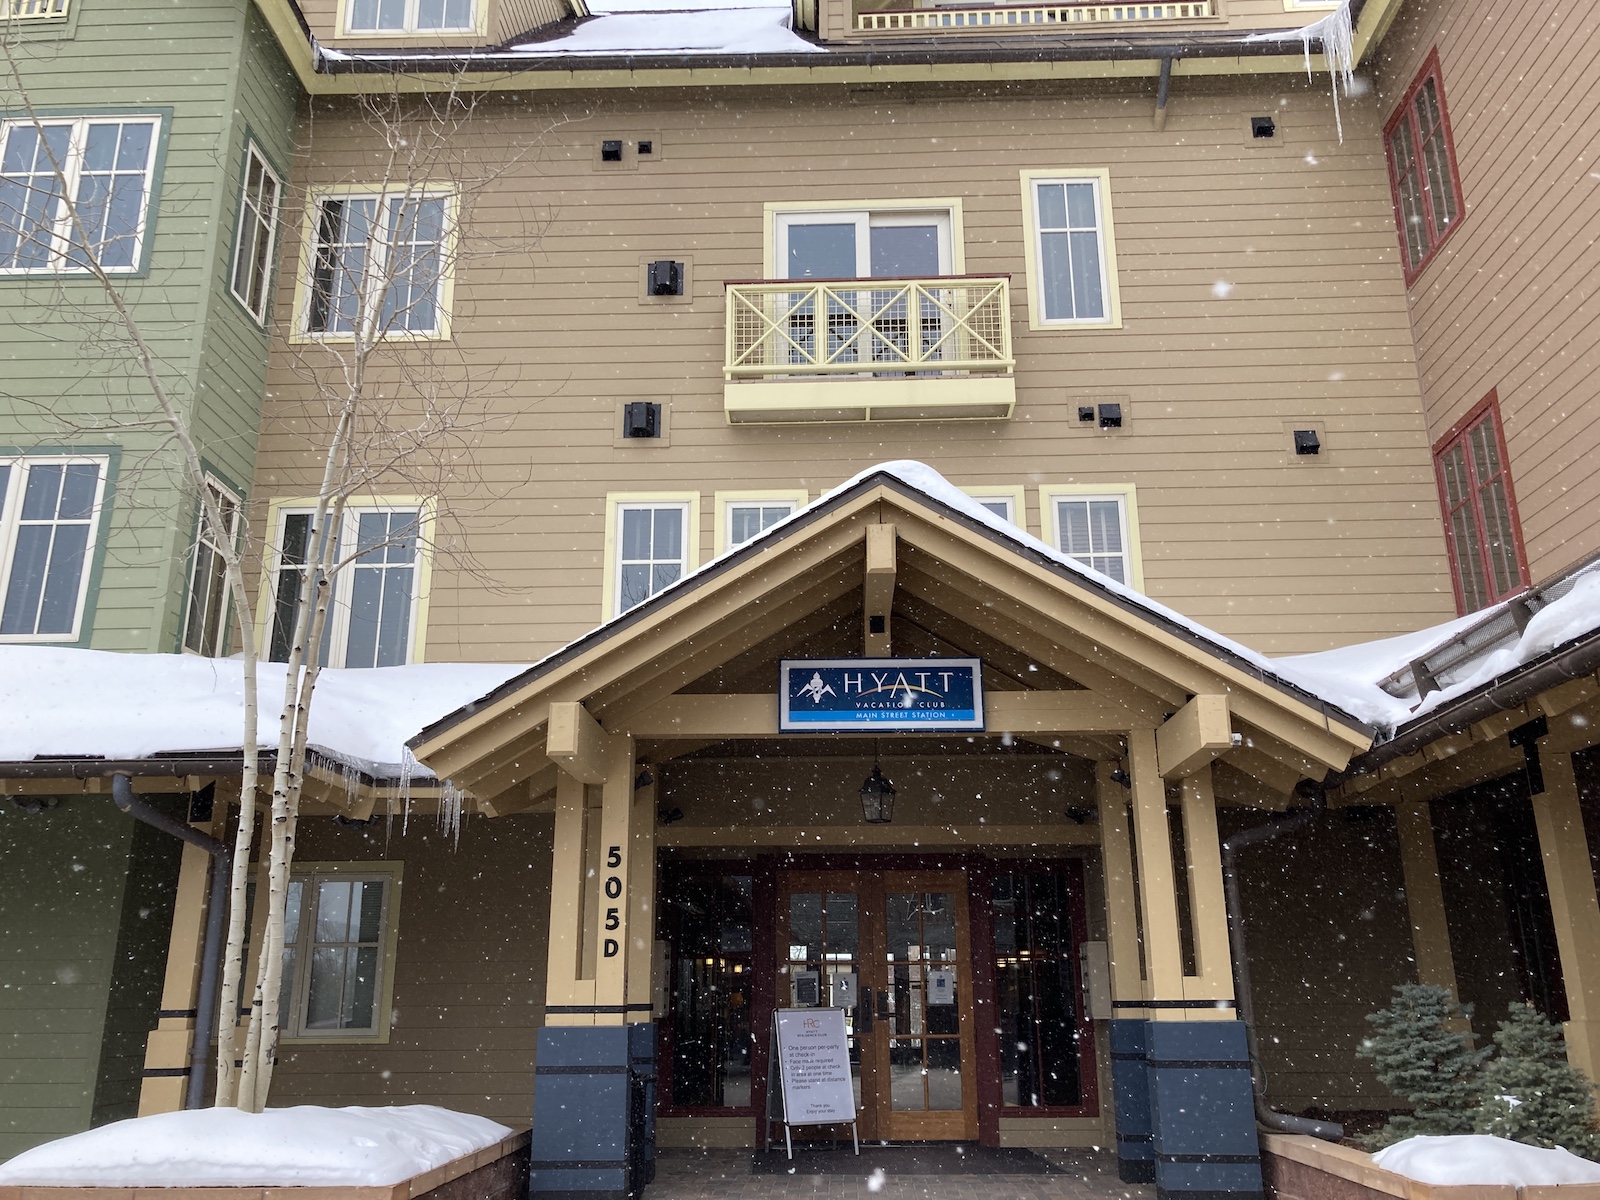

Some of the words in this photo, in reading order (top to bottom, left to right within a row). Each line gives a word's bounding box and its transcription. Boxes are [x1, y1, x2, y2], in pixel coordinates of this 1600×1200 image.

[844, 672, 954, 698] HYATT
[911, 711, 946, 719] STATION
[802, 1018, 820, 1029] HRC
